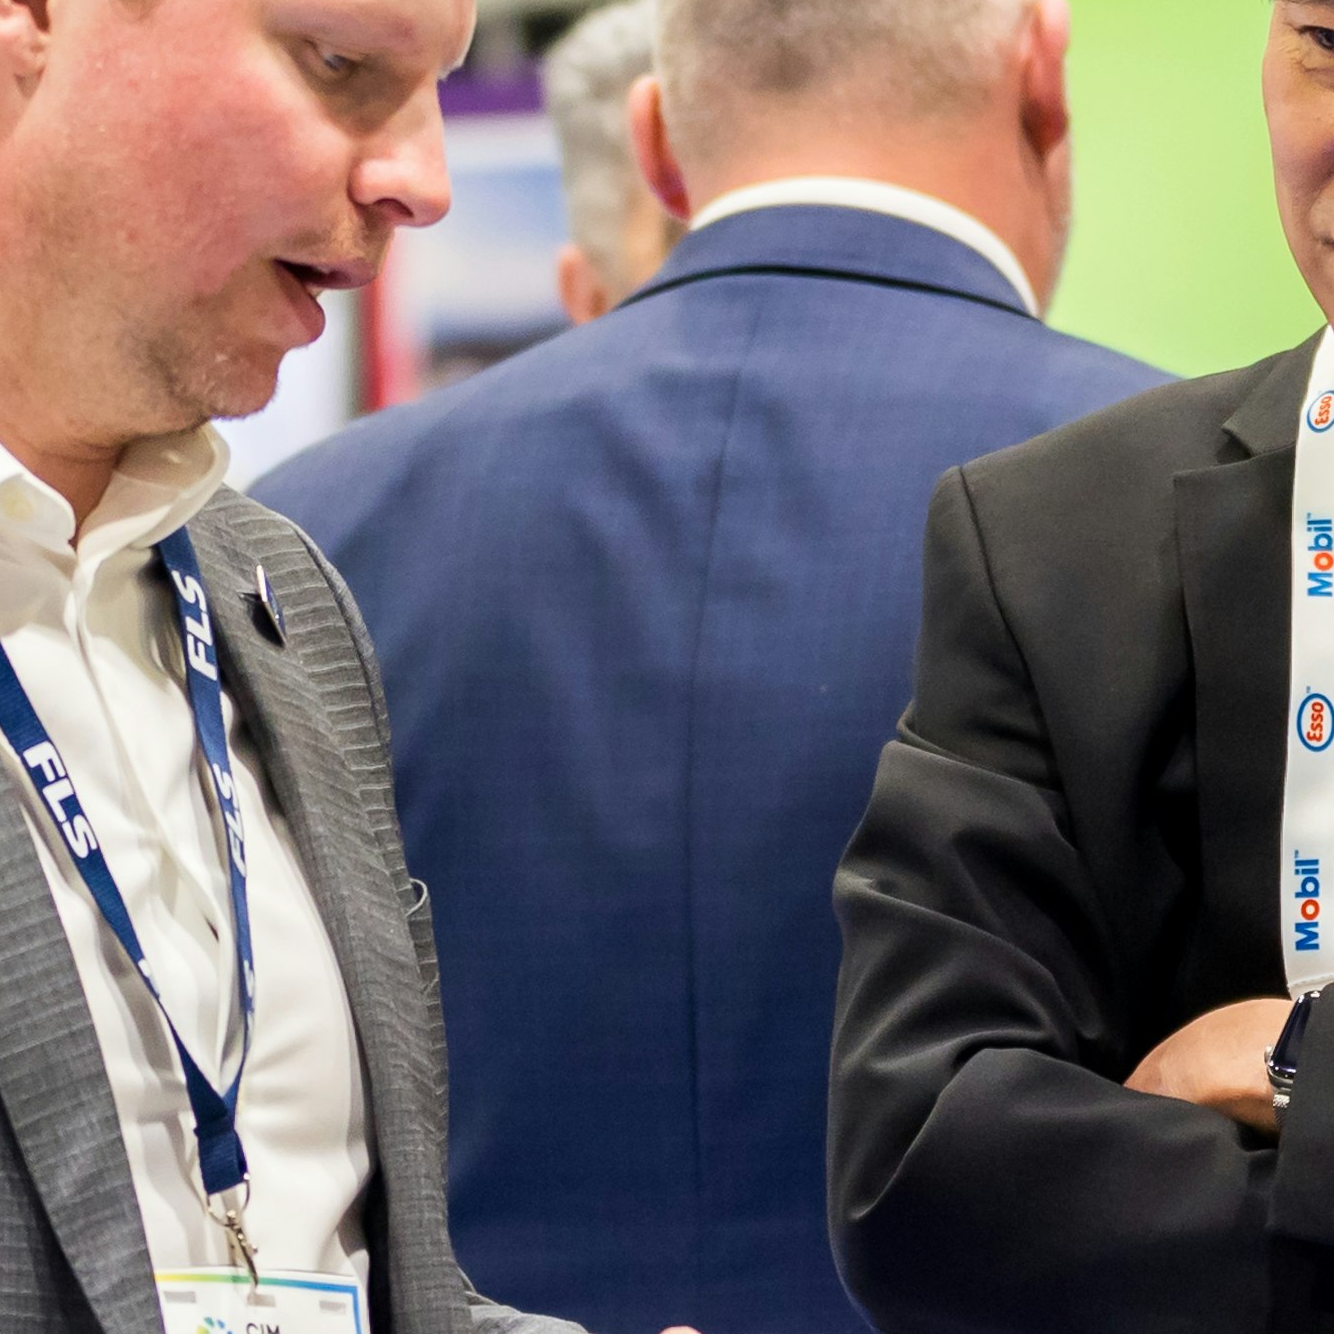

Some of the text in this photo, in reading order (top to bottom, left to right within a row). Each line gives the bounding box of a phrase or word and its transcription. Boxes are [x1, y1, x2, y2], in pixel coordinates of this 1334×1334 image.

[171, 569, 218, 681] FLS
[23, 741, 99, 859] FLS
[212, 762, 248, 878] FLS
